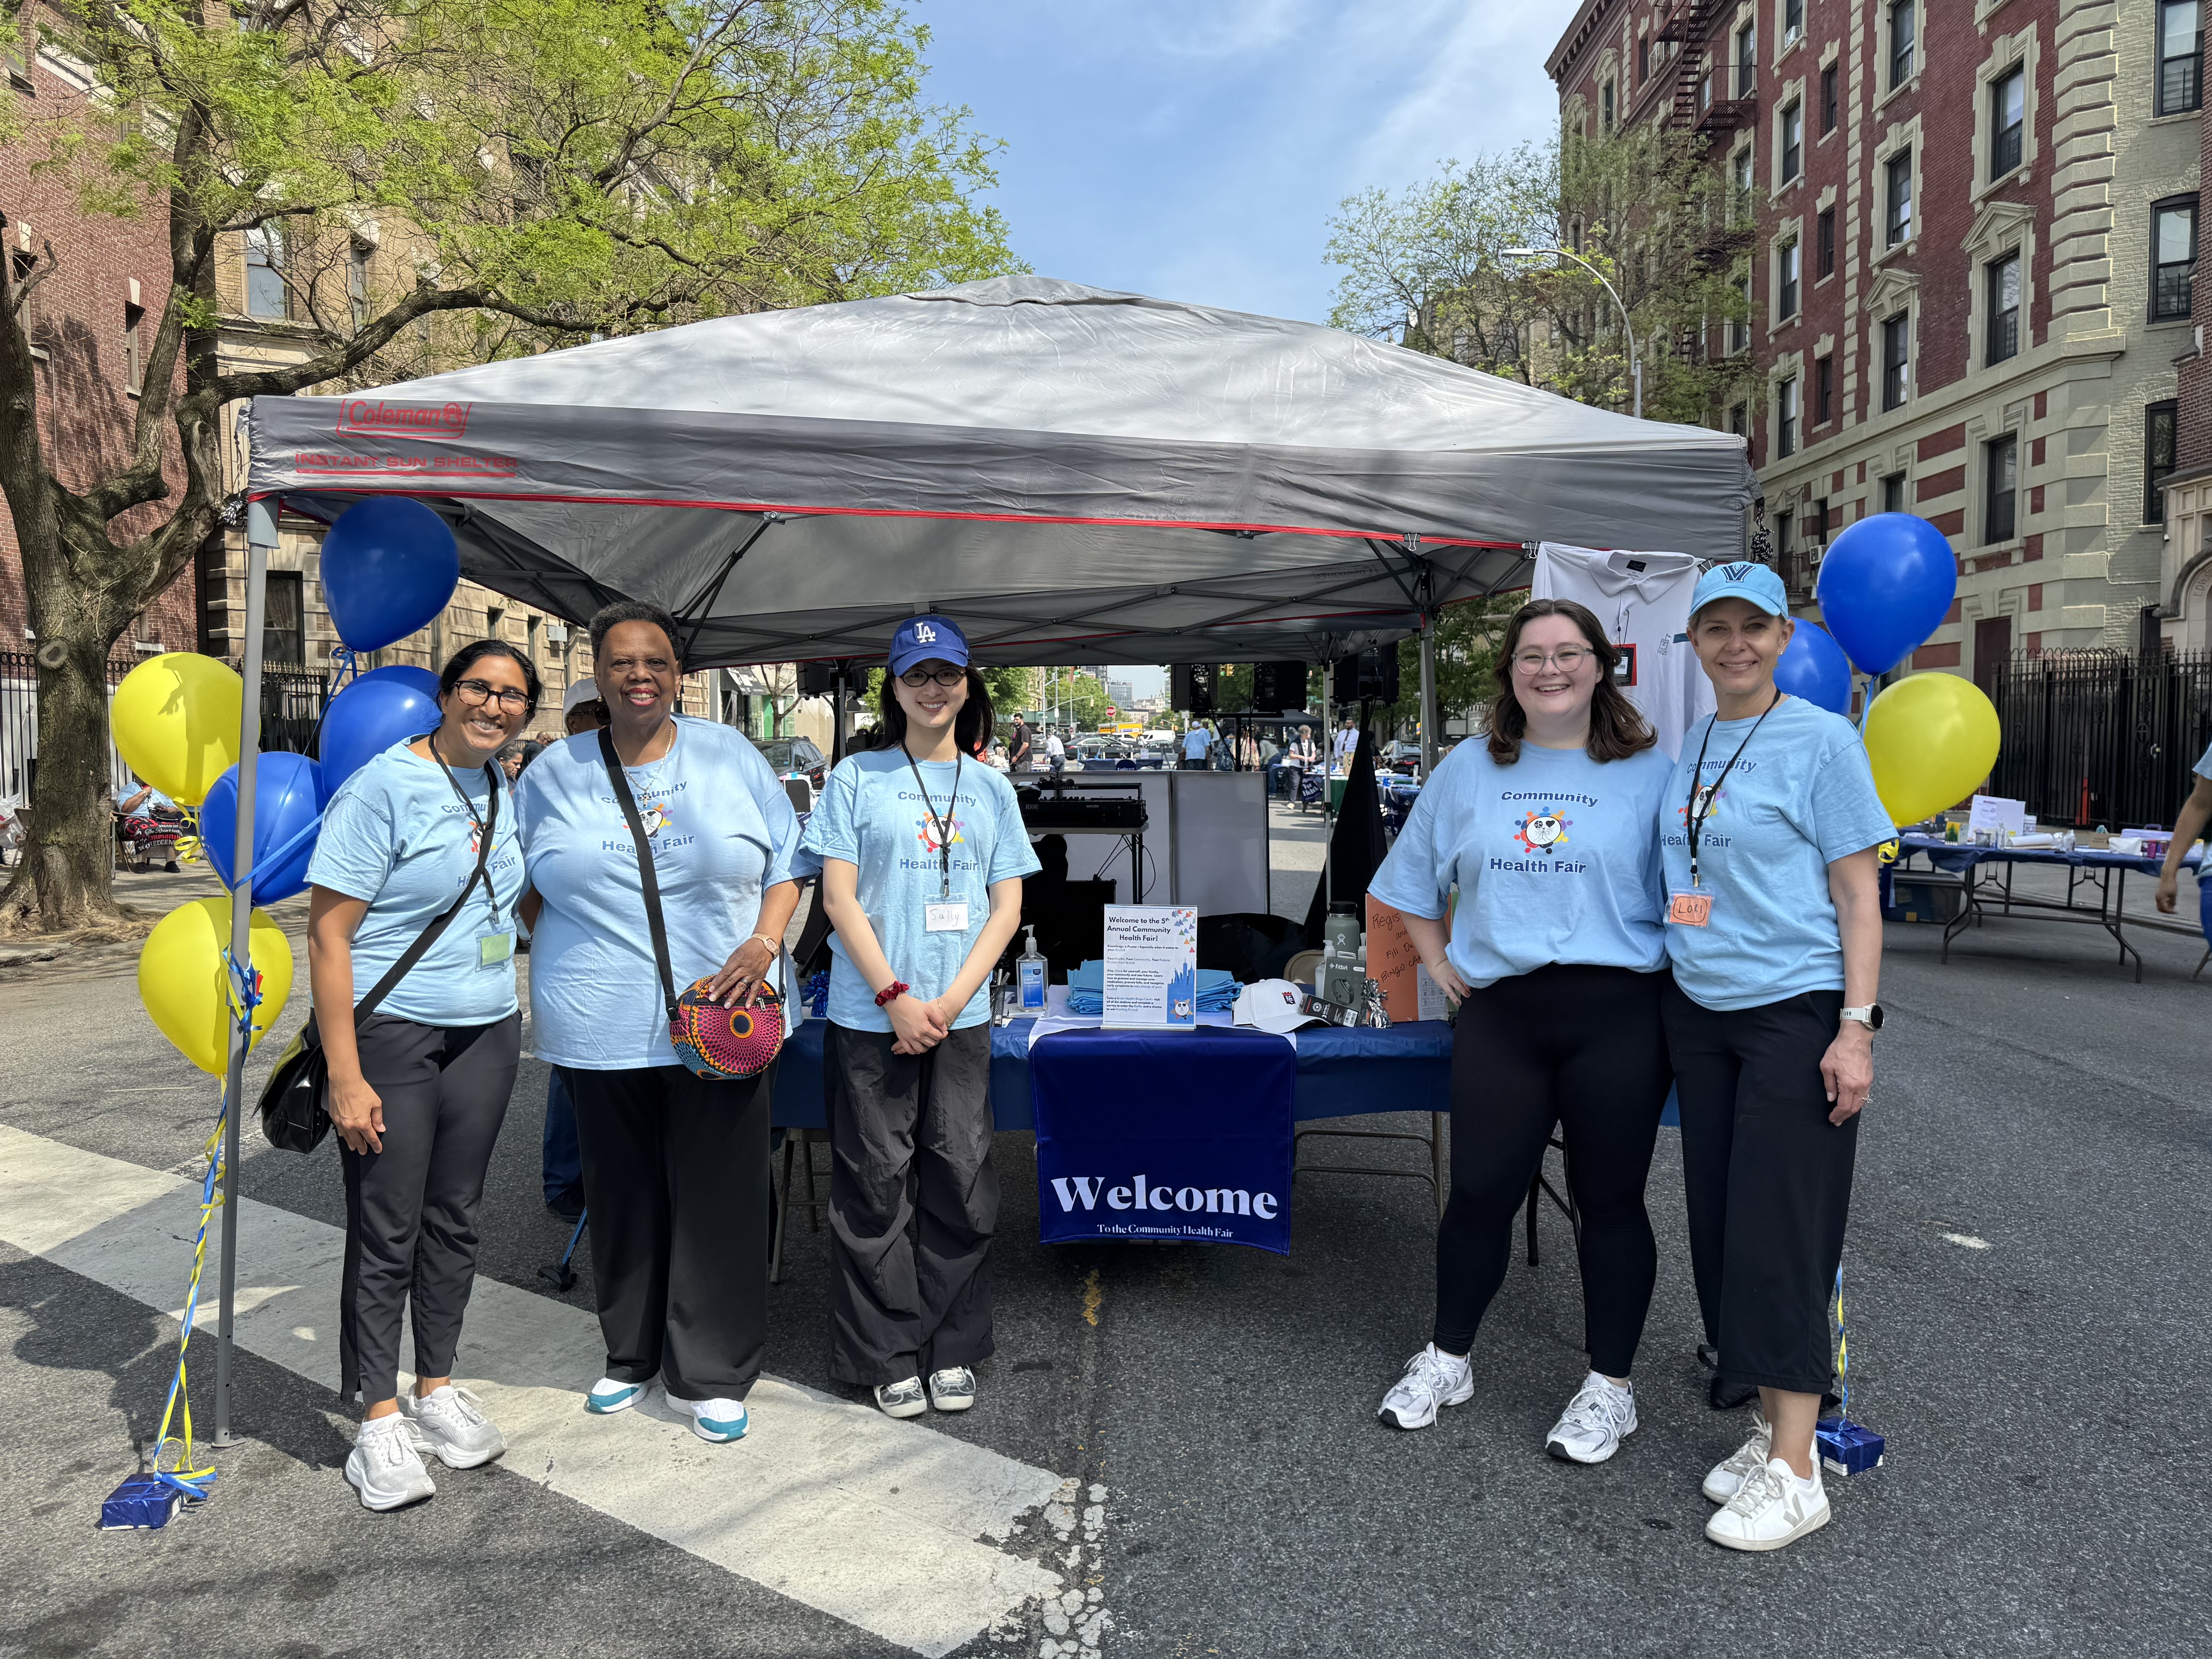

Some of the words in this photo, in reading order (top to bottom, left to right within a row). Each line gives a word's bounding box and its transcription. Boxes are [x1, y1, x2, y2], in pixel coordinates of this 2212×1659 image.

[349, 400, 441, 426] Coleman
[295, 453, 379, 467] INSTANT
[386, 457, 426, 467] SUN
[434, 457, 517, 468] SHELTER
[916, 622, 936, 643] LA
[1501, 791, 1598, 807] Community
[663, 835, 695, 850] Fair
[1704, 834, 1731, 847] Fair
[490, 855, 516, 873] Fair
[953, 860, 978, 871] Fair
[1491, 858, 1548, 872] Health
[1555, 860, 1586, 873] Fair
[930, 909, 959, 927] Sally
[1372, 913, 1402, 931] Regis
[1133, 926, 1171, 934] Community
[1396, 926, 1408, 939] and
[1386, 948, 1398, 959] Fill
[1381, 963, 1405, 982] BINGO
[1051, 1174, 1278, 1219] Welcome
[1097, 1224, 1111, 1233] To
[1112, 1224, 1127, 1233] the
[1128, 1224, 1182, 1235] Community
[1183, 1226, 1213, 1237] Health
[1215, 1228, 1233, 1237] Fair
